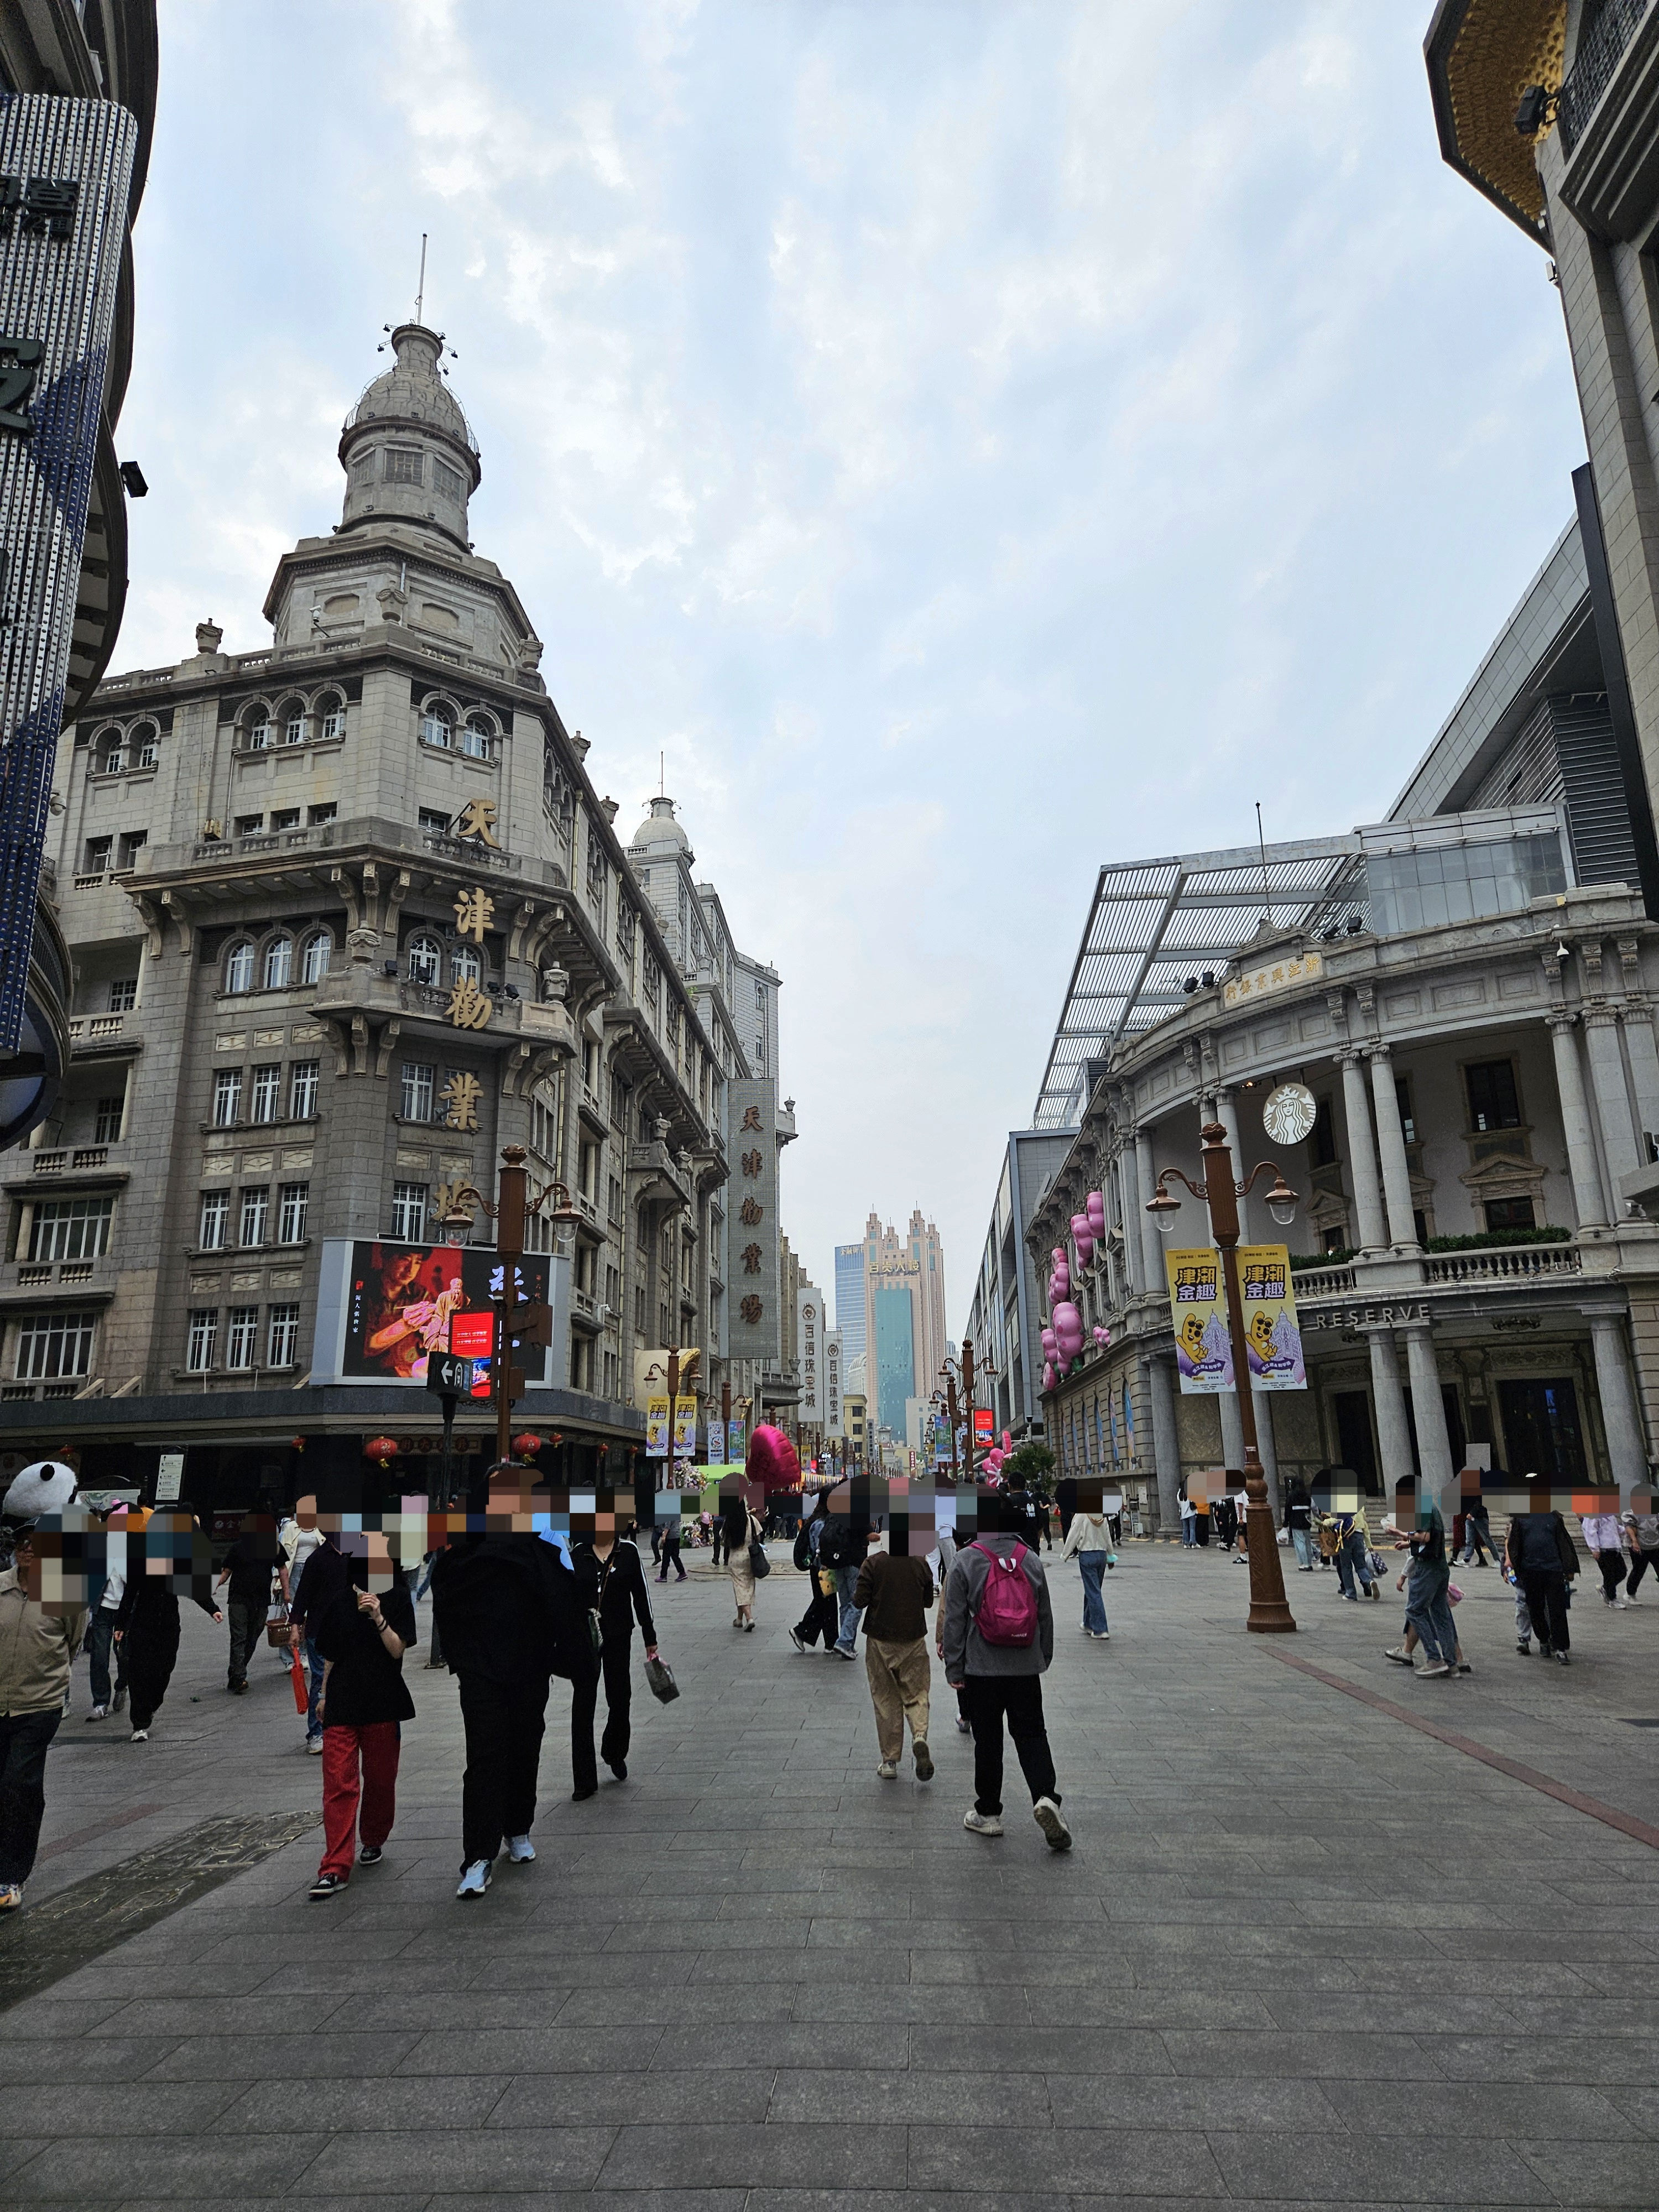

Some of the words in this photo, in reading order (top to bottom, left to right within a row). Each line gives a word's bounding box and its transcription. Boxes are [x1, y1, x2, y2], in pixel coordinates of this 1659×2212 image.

[1176, 1267, 1215, 1285] 津潮
[1244, 1265, 1284, 1282] 津潮
[1178, 1285, 1215, 1301] 金趣
[1246, 1282, 1285, 1299] 金趣
[1316, 1304, 1431, 1328] RESERVE
[805, 1324, 816, 1408] 百信珠宝城
[830, 1360, 838, 1425] 百信珠宝城
